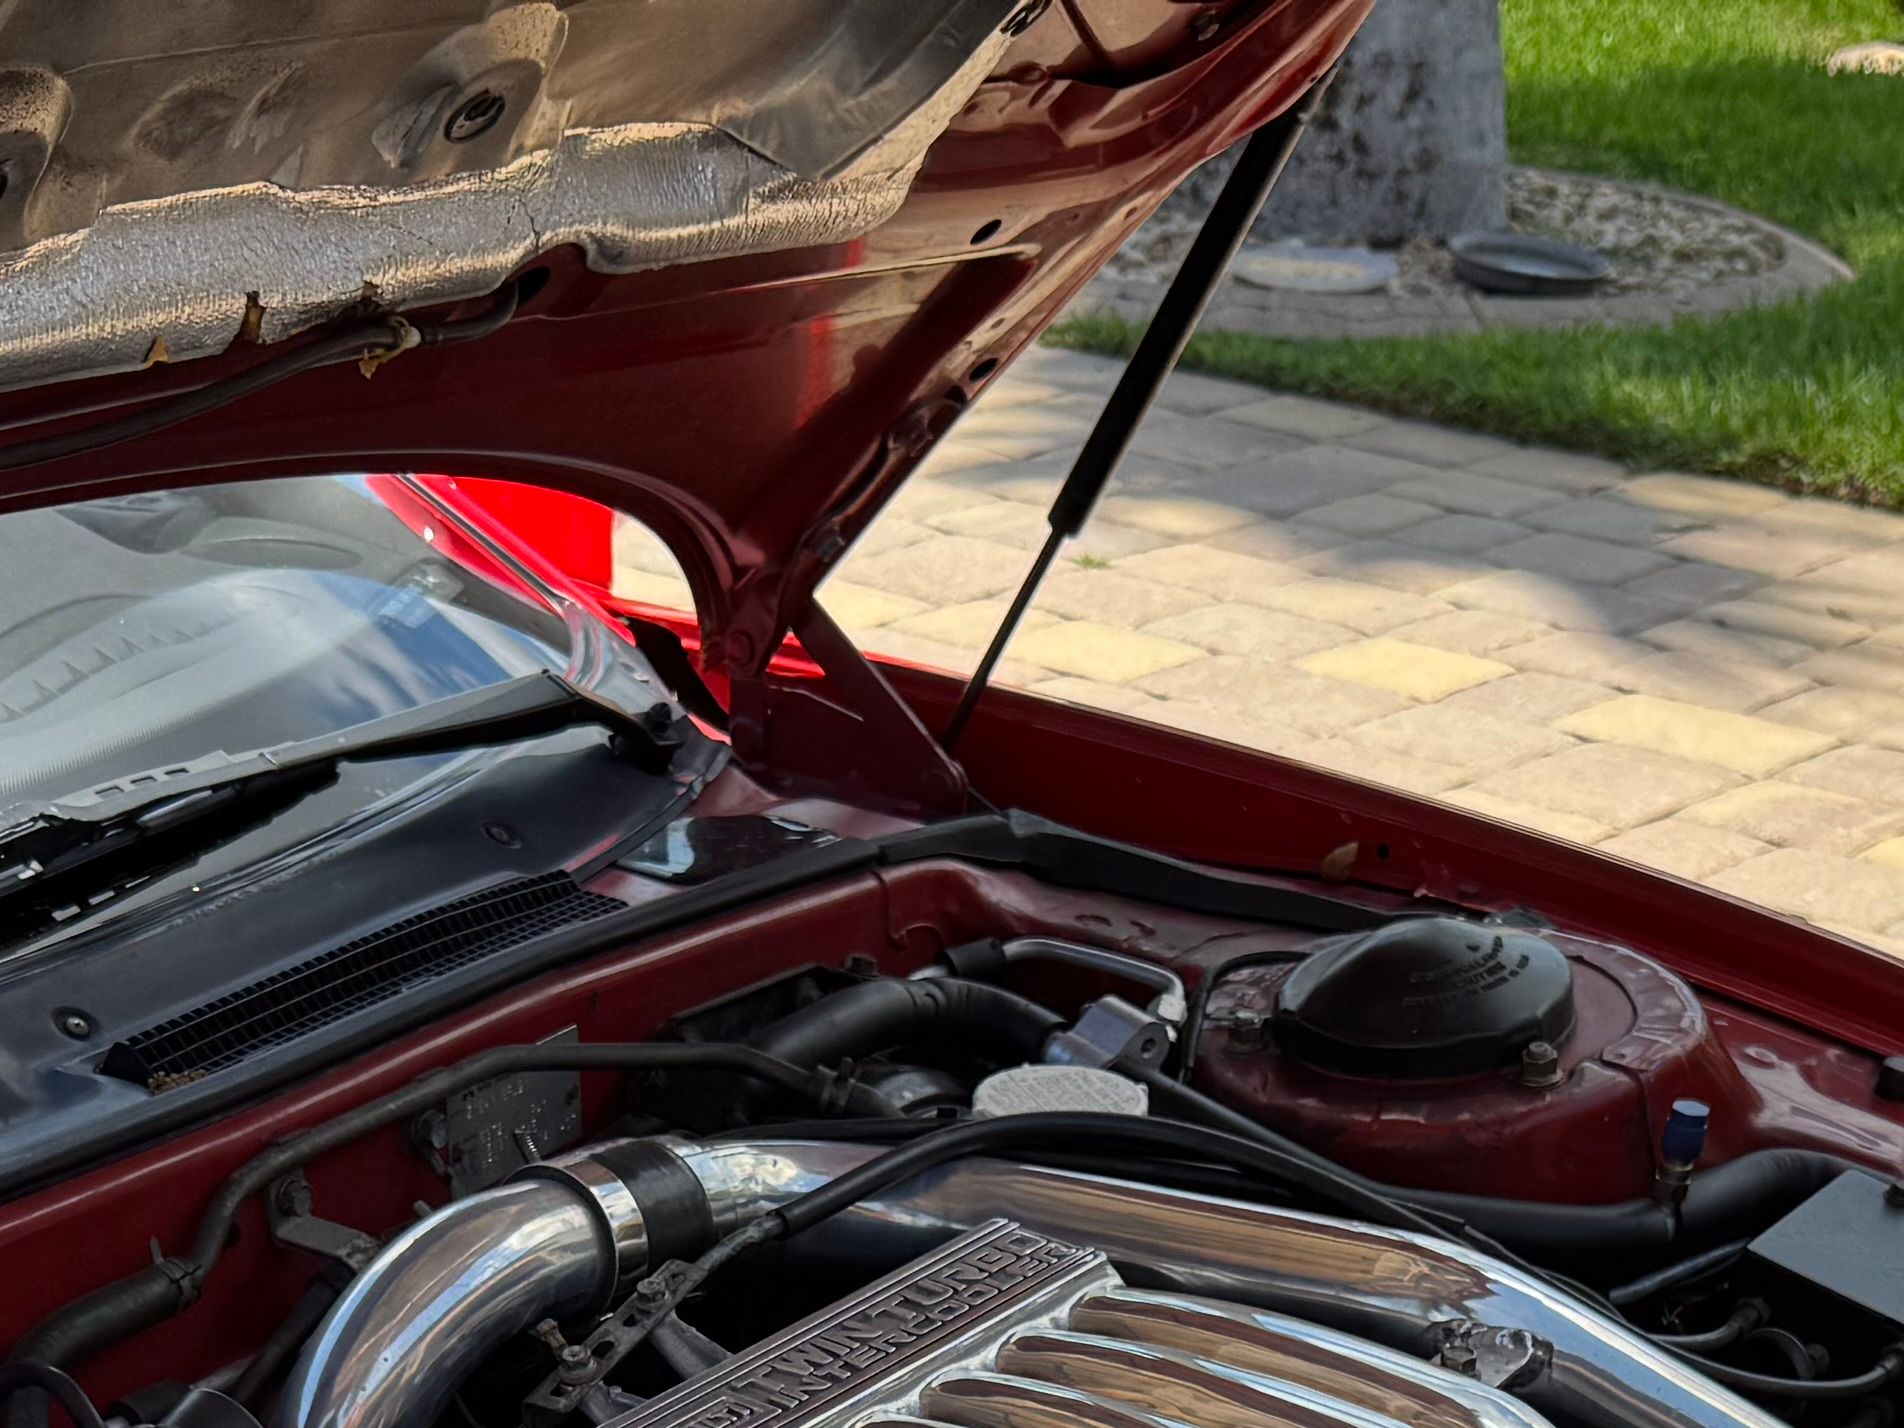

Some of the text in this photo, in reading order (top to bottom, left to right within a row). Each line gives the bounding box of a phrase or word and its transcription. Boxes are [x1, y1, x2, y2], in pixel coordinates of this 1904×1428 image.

[732, 1229, 1047, 1411] TWIN TURBO
[777, 1240, 1081, 1408] INTERCOOLER
